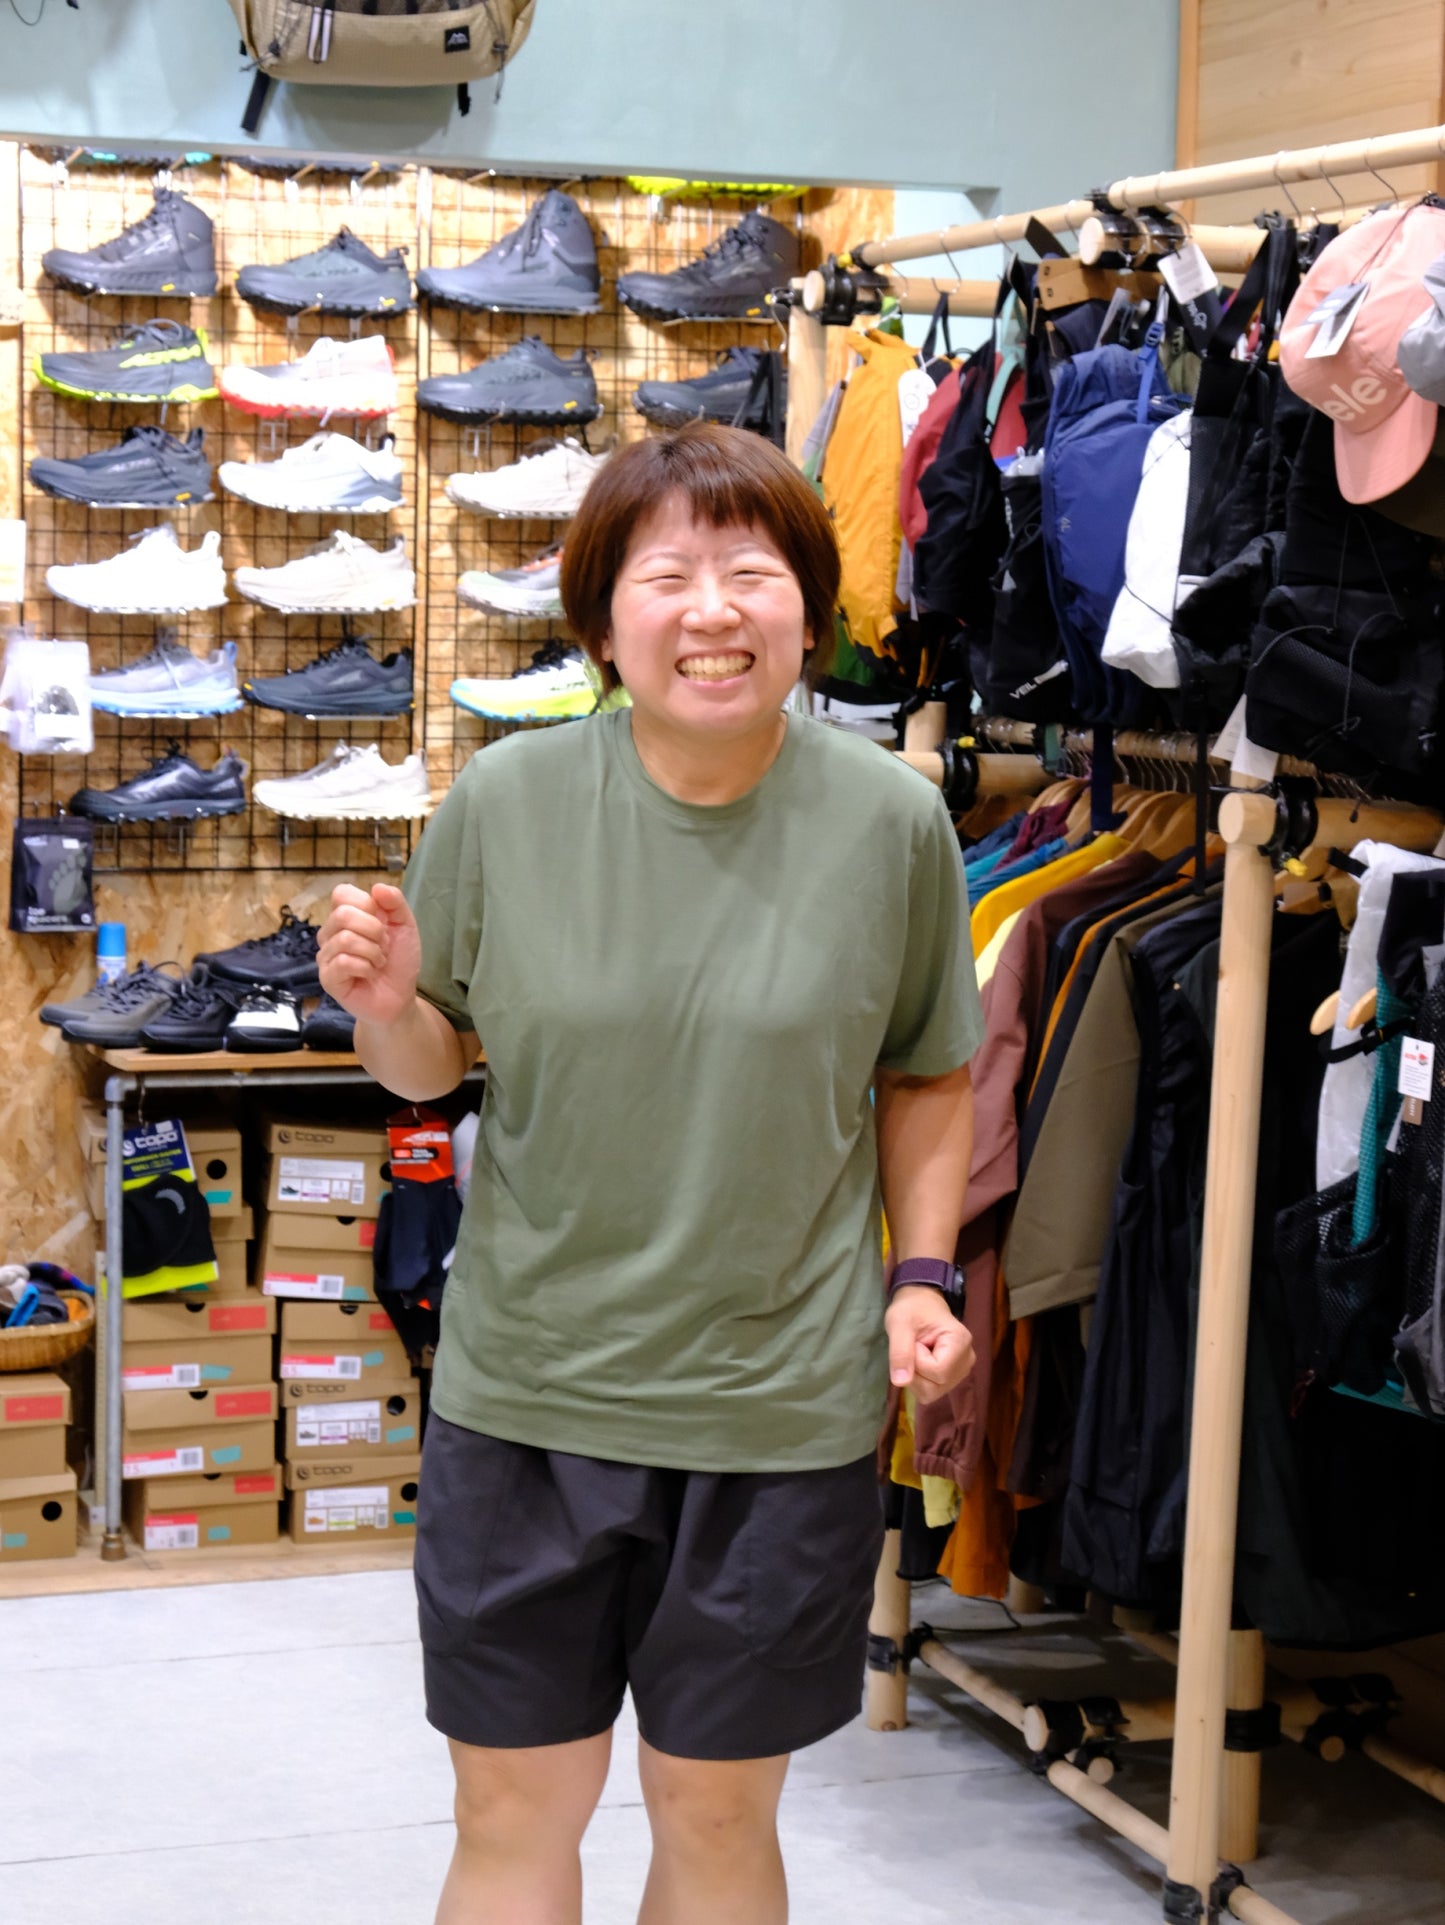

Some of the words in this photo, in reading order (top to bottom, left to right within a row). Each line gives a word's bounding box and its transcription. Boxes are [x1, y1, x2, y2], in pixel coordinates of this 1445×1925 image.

[134, 1130, 179, 1149] topo
[295, 1131, 335, 1144] topo
[305, 1383, 346, 1394] topo
[312, 1465, 353, 1476] topo
